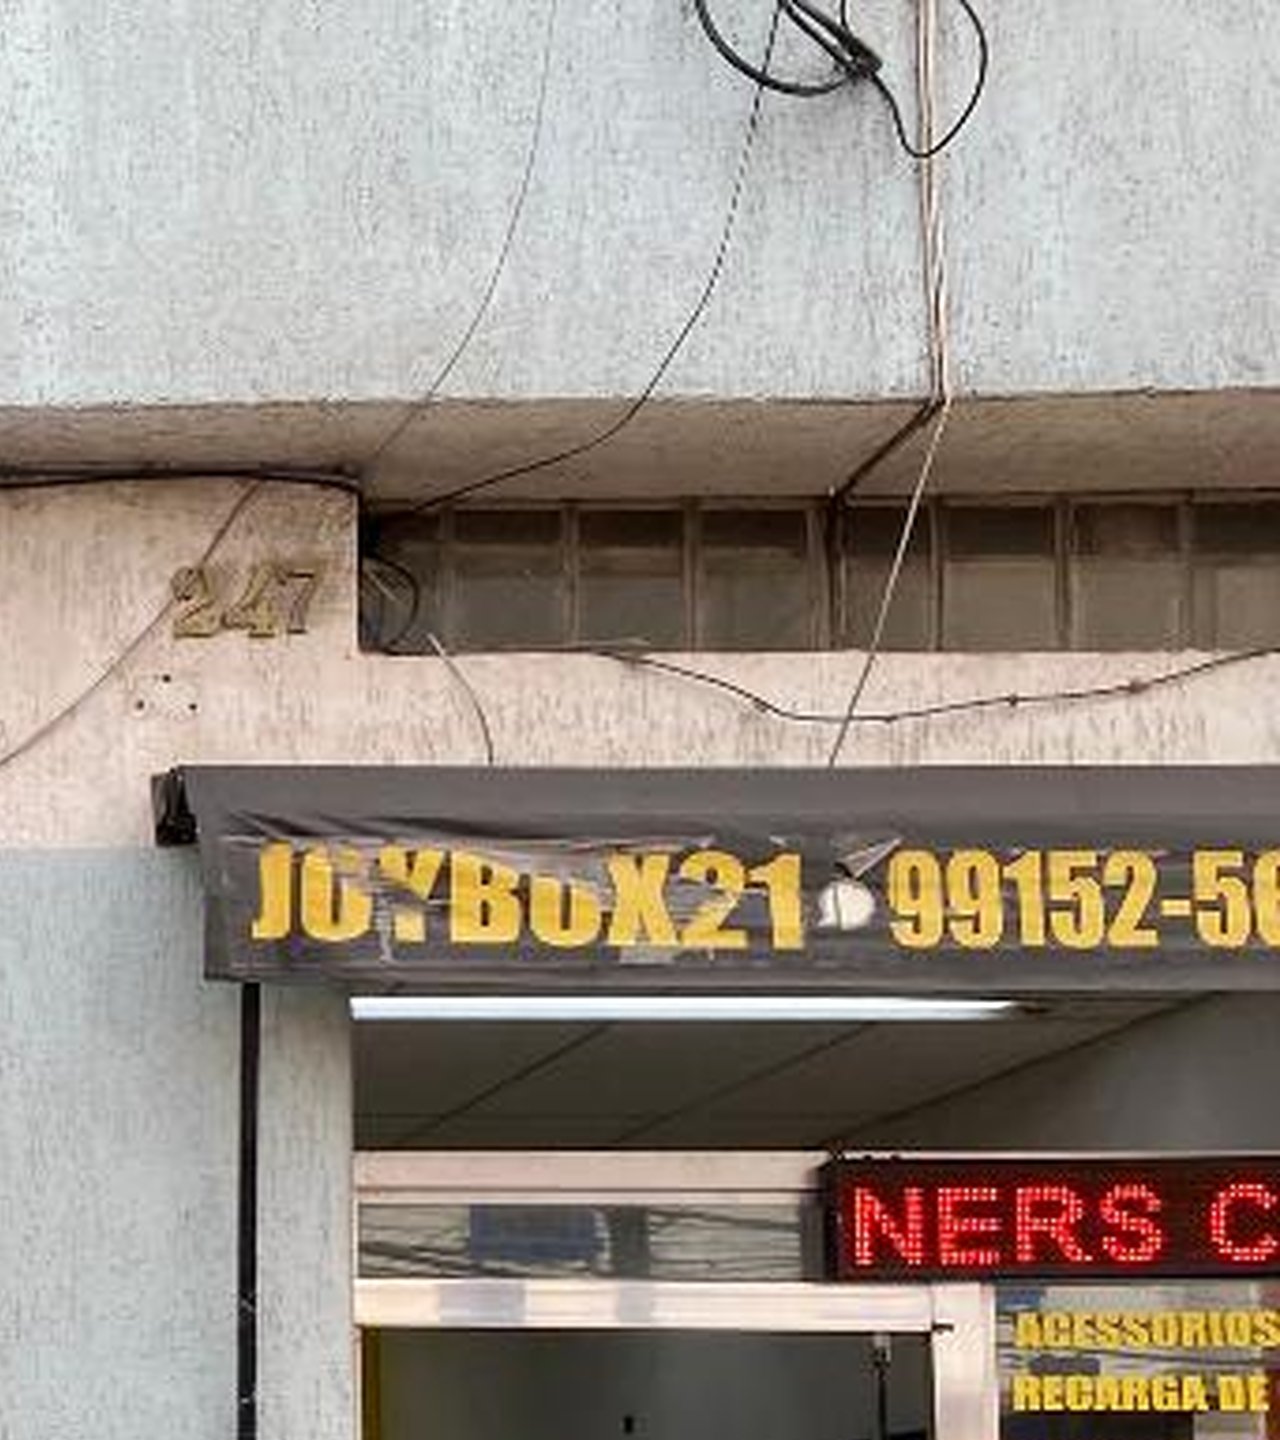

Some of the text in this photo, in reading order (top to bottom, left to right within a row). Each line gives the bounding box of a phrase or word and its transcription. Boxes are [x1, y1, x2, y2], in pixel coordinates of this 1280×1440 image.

[171, 563, 324, 637] 247
[854, 1184, 1162, 1266] NERS
[1013, 1374, 1270, 1412] RECARGA DE
